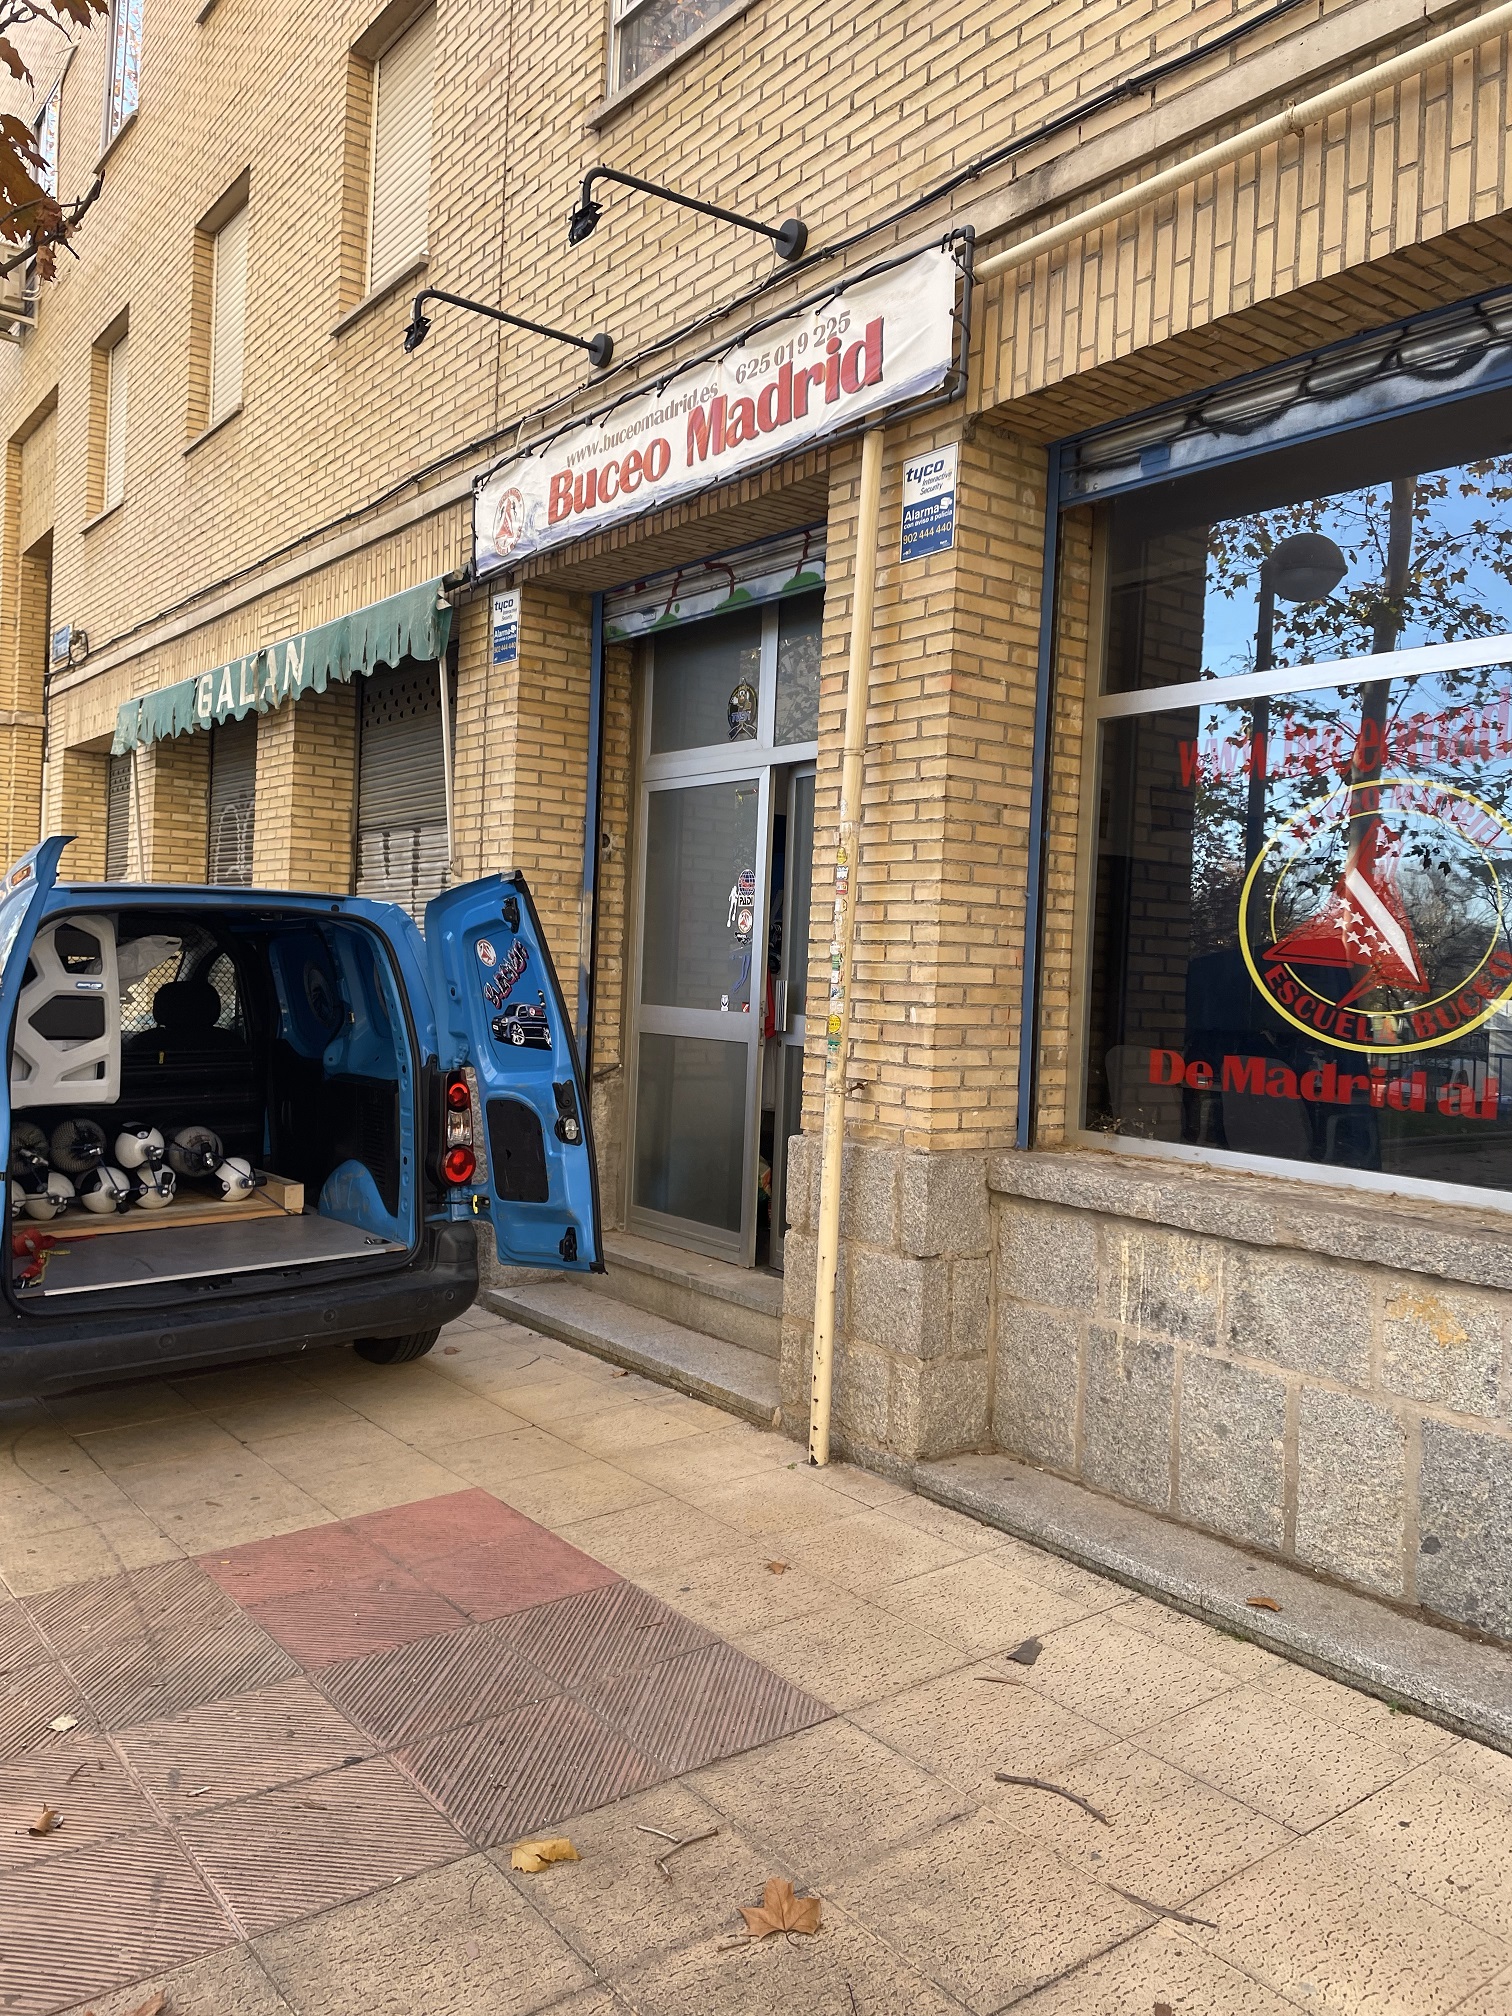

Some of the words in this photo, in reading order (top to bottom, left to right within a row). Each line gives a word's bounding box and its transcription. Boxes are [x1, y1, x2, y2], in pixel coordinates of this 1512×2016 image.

[566, 382, 719, 468] www.buceomadrid.es
[735, 352, 771, 385] 625
[774, 332, 809, 367] 019
[813, 309, 851, 348] 225
[547, 437, 672, 526] Buceo
[686, 315, 885, 468] Madrid
[905, 459, 945, 483] tyco
[922, 470, 953, 487] Interactive
[919, 482, 944, 496] Security
[903, 522, 914, 530] con
[915, 517, 929, 527] aviso
[904, 504, 940, 524] Alarma
[903, 531, 918, 545] 902
[919, 525, 935, 540] 444
[936, 521, 952, 535] 440
[494, 598, 514, 612] tyco
[197, 636, 306, 718] GALAN
[1264, 964, 1399, 1043] ESCUELA
[1411, 951, 1512, 1039] BUCEO
[1149, 1048, 1213, 1090] De
[1222, 1055, 1427, 1114] Madrid
[1437, 1077, 1498, 1121] al
